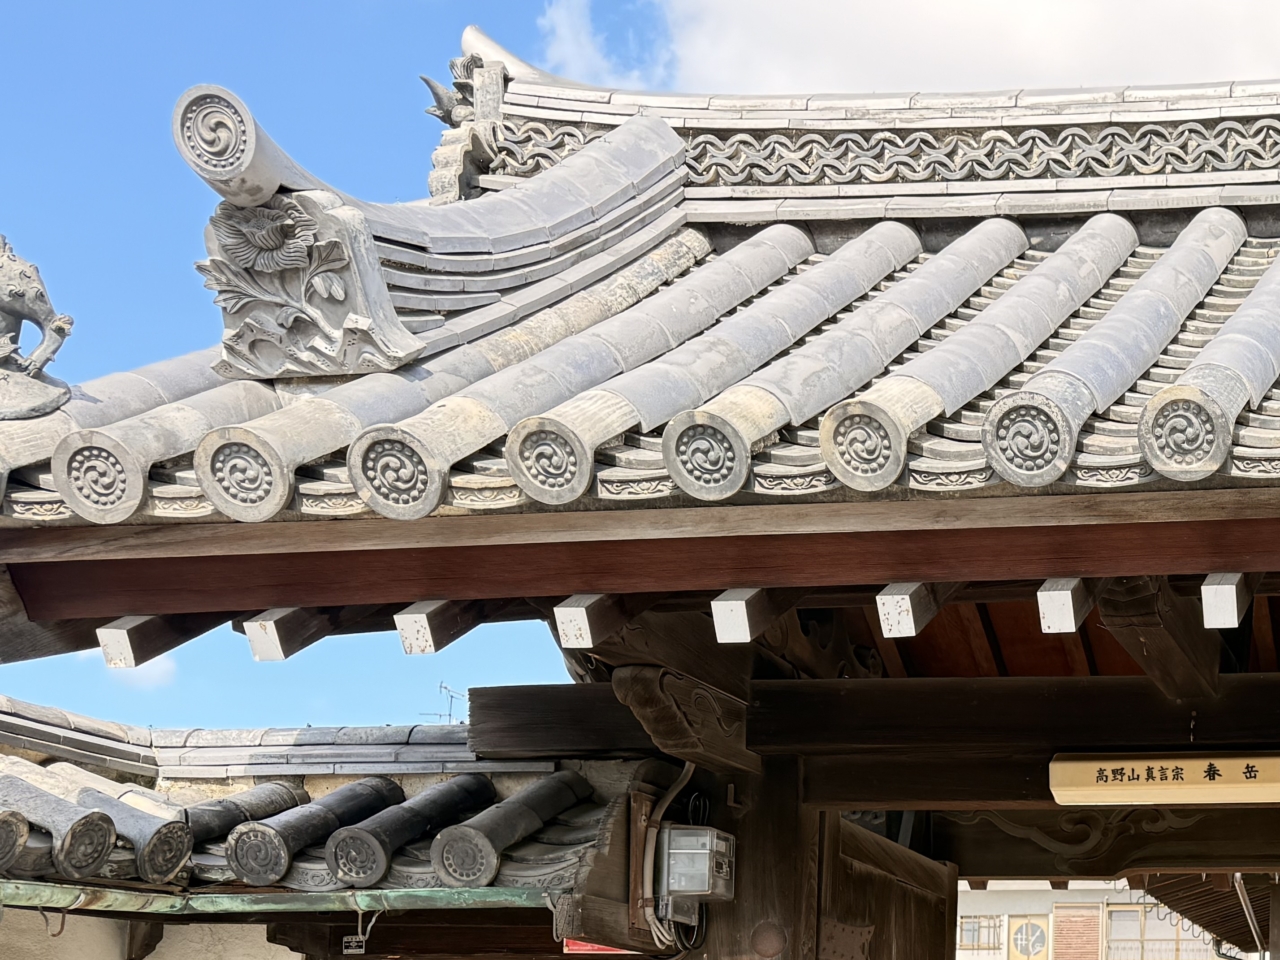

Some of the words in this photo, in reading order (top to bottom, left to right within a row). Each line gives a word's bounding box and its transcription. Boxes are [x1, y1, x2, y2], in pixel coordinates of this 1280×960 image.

[1095, 765, 1185, 783] 高野山真言宗
